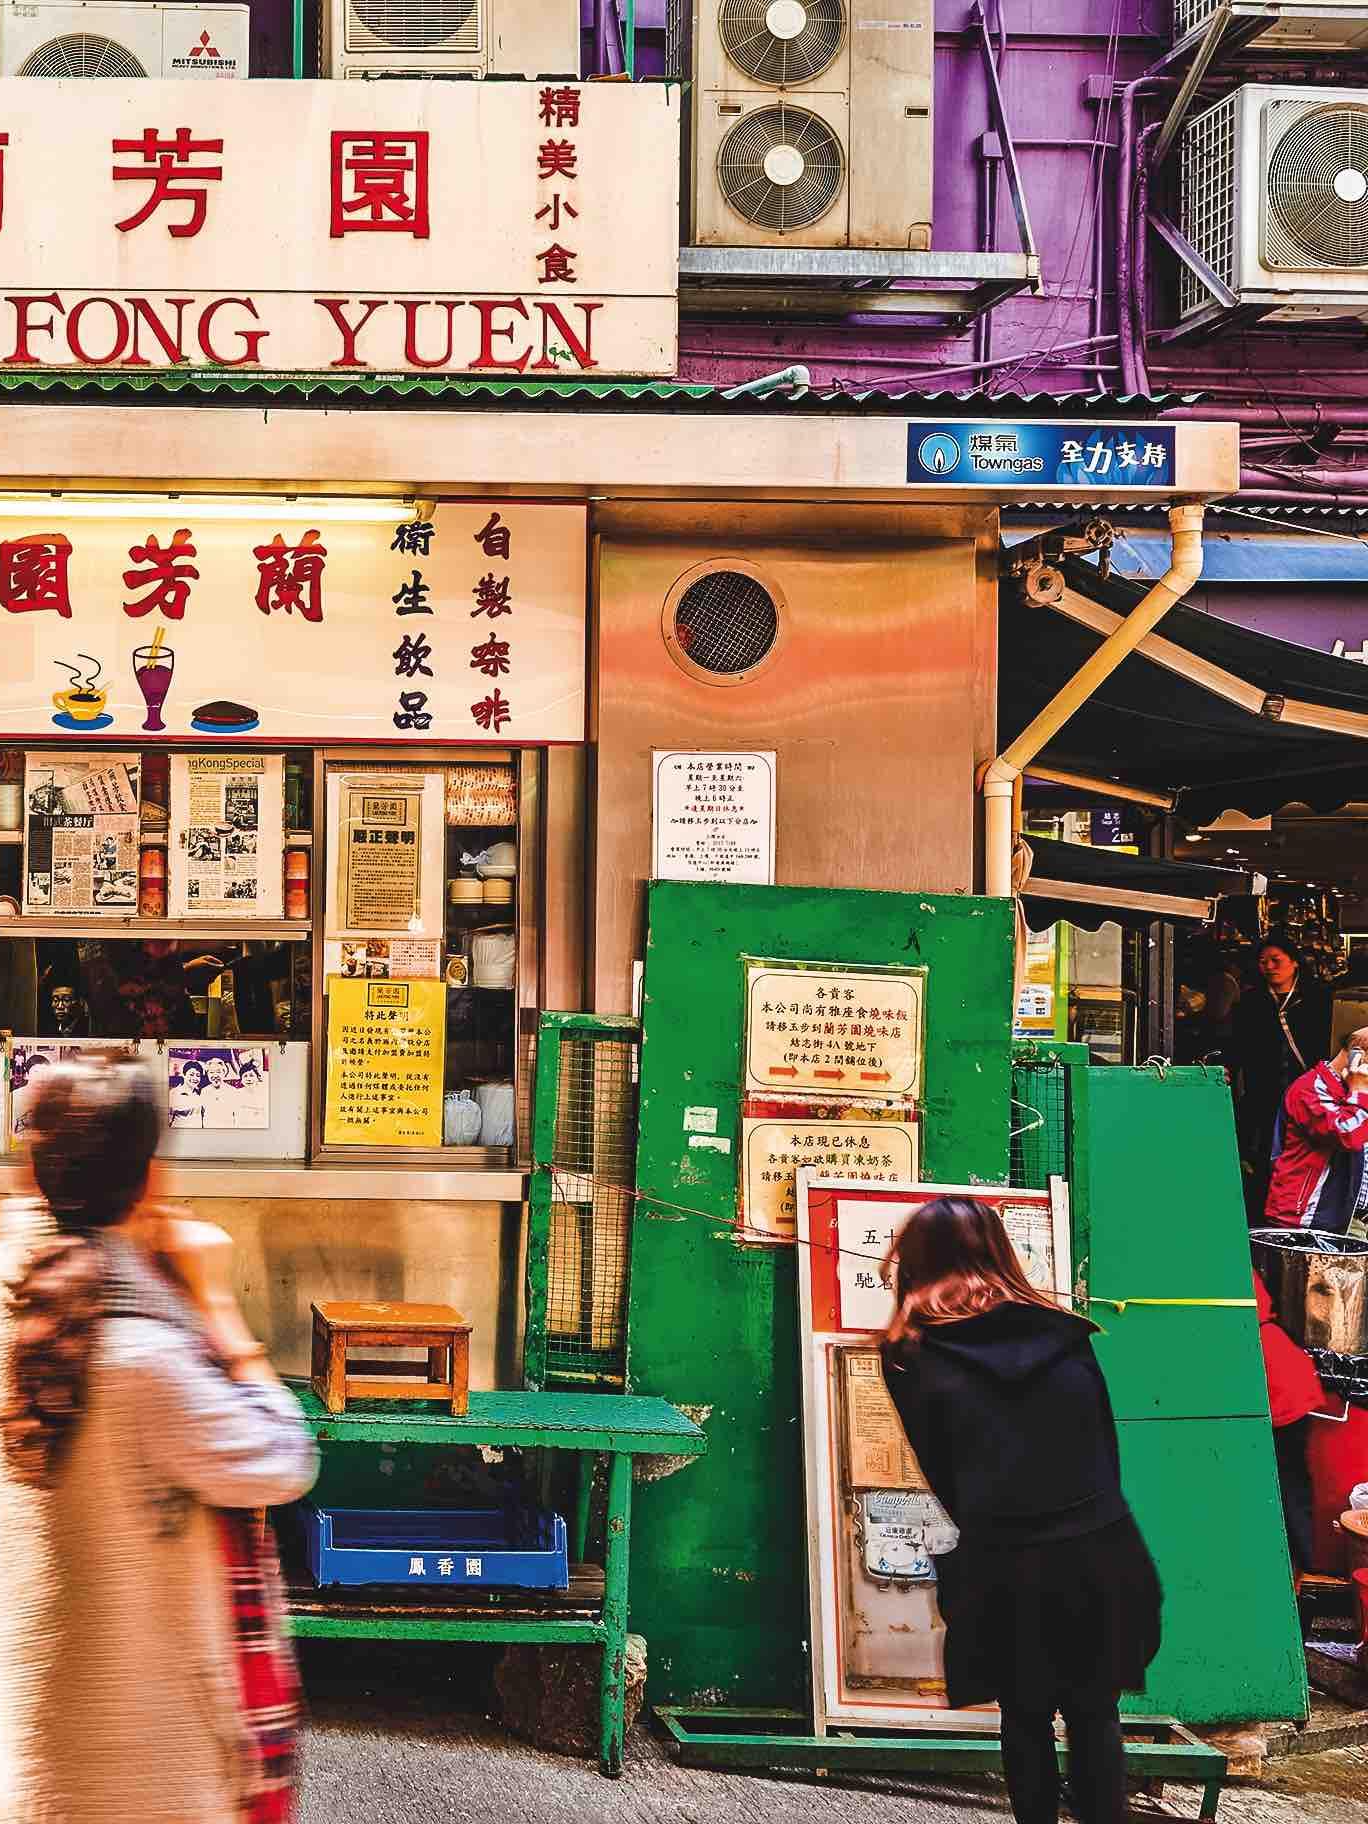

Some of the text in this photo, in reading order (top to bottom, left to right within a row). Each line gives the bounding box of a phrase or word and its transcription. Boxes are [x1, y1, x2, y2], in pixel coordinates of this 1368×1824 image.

[172, 58, 237, 66] MITSUBISHI
[535, 85, 581, 284] 精美小食
[4, 292, 269, 367] FONG
[315, 297, 604, 374] YUEN
[969, 433, 1018, 452] 煤氣
[970, 455, 1043, 473] Towngas
[1060, 440, 1167, 474] 全力支持
[815, 986, 856, 1001] 各貴客
[789, 1134, 872, 1149] 本店現已休息
[408, 1557, 482, 1577] 鳳香園
